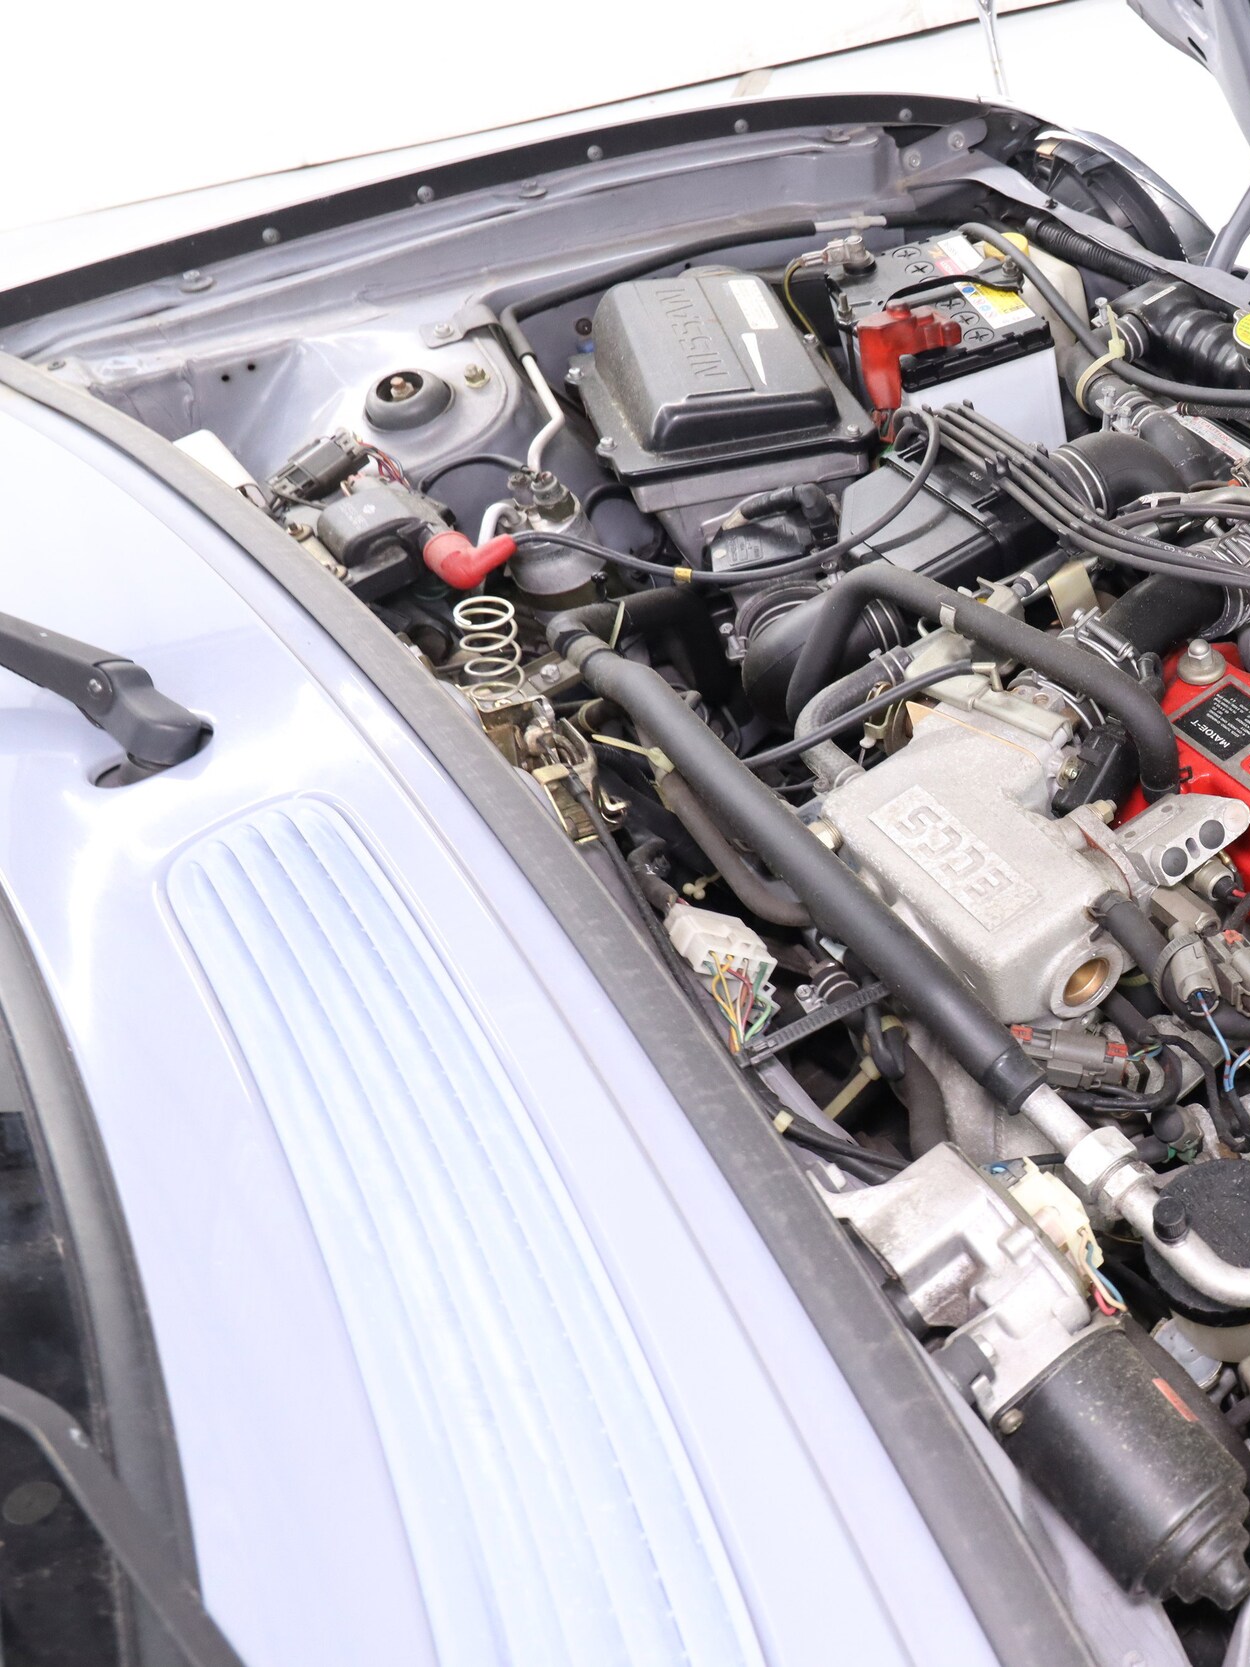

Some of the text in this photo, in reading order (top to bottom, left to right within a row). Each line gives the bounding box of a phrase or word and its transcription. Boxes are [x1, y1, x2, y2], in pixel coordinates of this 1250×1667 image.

[655, 288, 729, 377] NISSAN
[1190, 719, 1230, 748] MA10E-T
[894, 805, 1014, 899] ECCS
